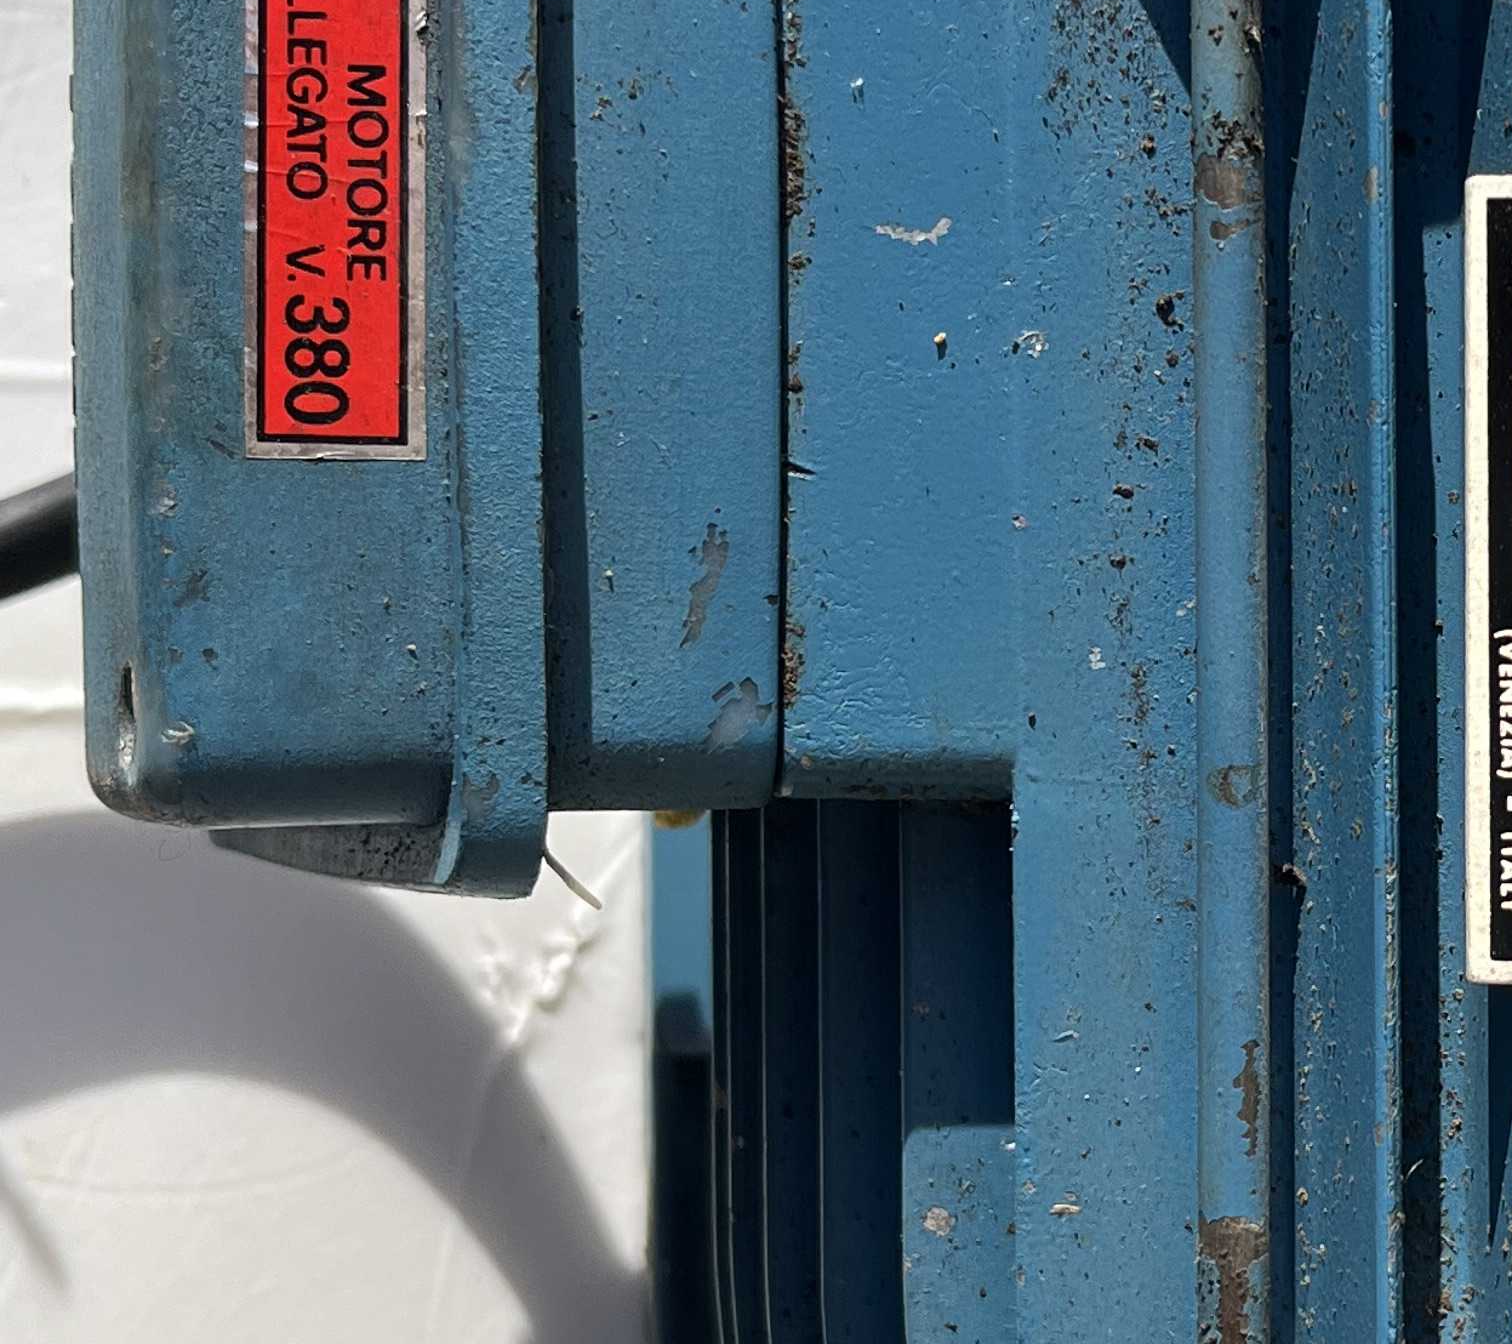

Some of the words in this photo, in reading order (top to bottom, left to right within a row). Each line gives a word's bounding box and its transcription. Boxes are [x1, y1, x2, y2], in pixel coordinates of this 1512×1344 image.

[347, 64, 388, 282] MOTORE
[286, 245, 326, 283] V.
[284, 294, 350, 425] 380
